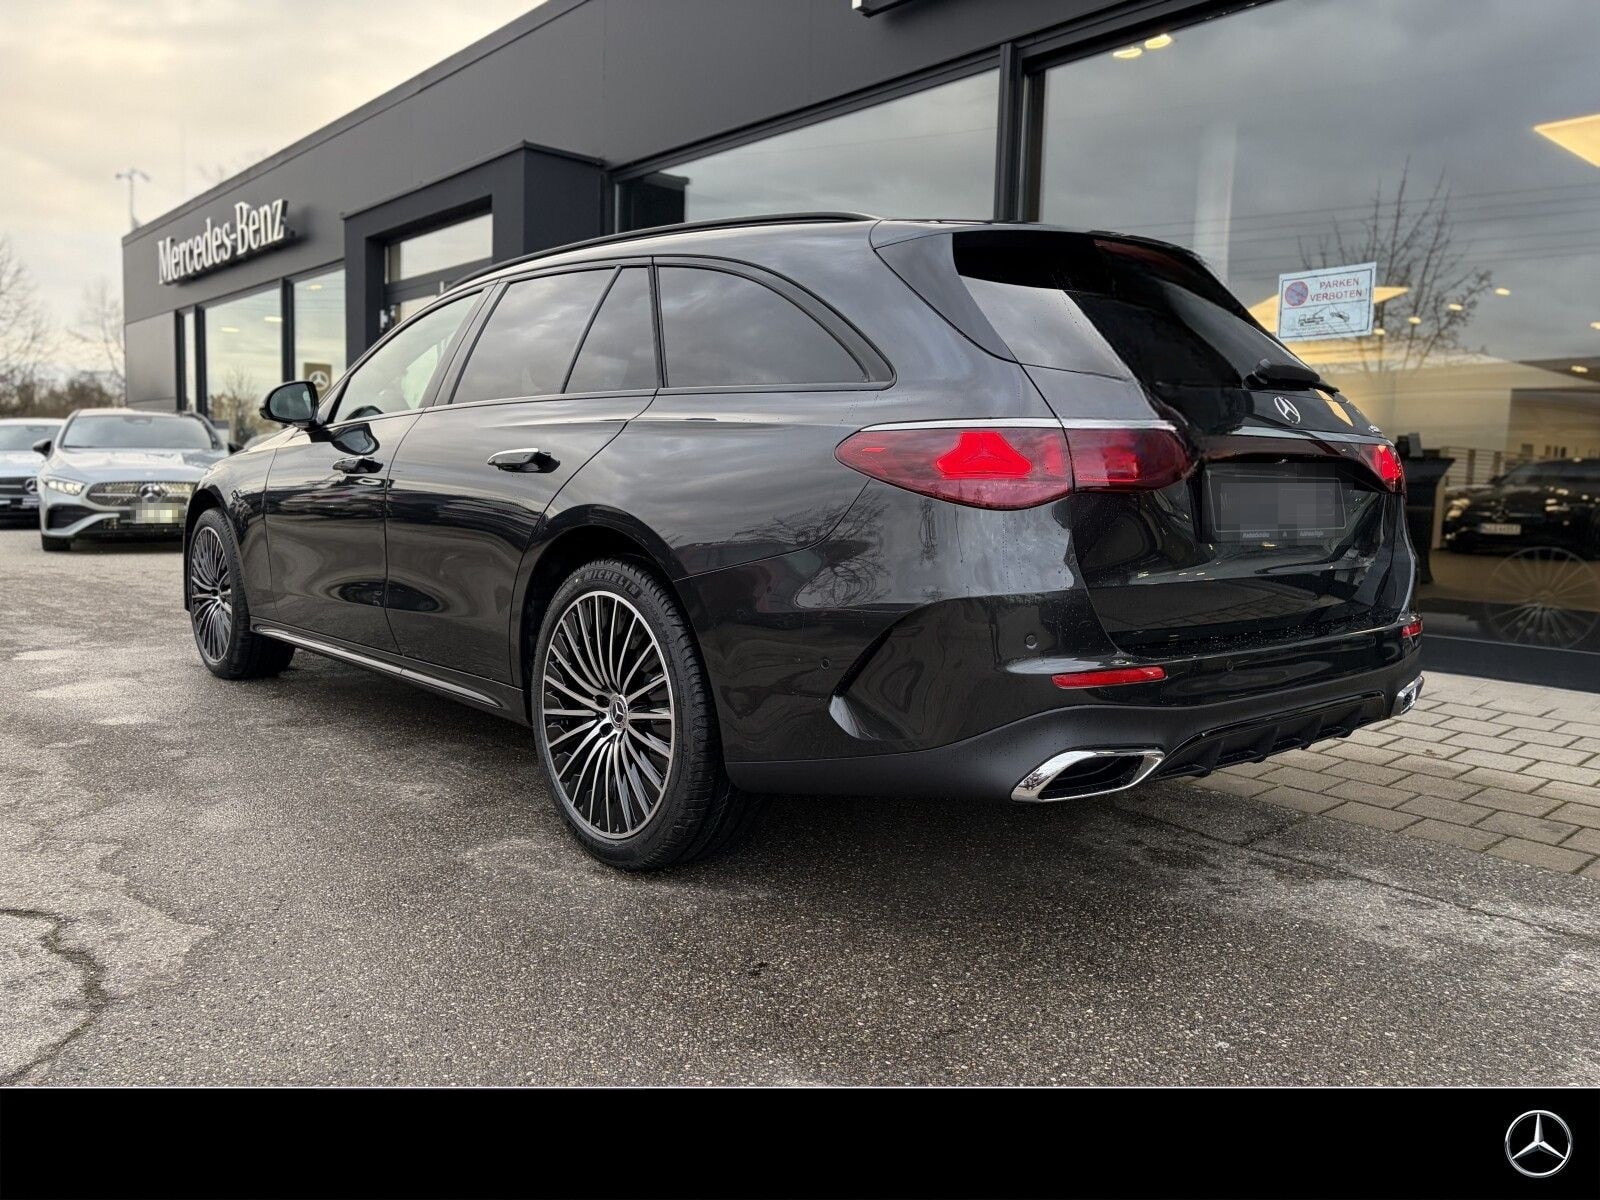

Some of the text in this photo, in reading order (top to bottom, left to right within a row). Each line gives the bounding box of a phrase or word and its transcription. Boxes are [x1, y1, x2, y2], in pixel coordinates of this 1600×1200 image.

[158, 199, 285, 284] Mercedes-Benz
[1320, 278, 1360, 289] PARKEN
[584, 569, 639, 595] MICHELIN
